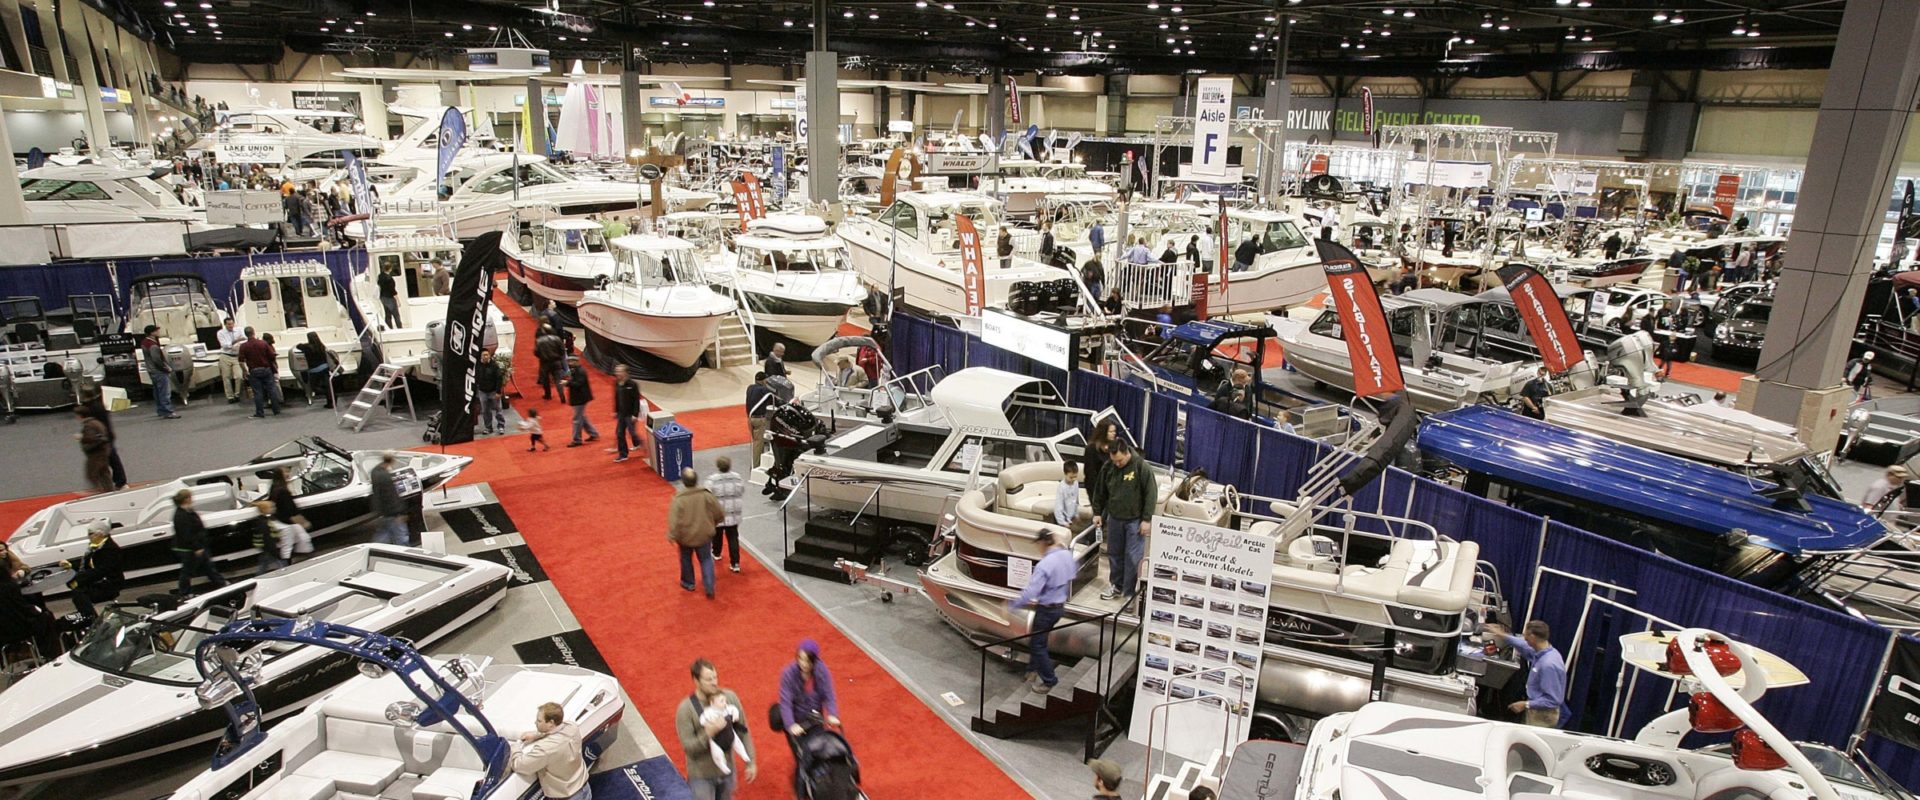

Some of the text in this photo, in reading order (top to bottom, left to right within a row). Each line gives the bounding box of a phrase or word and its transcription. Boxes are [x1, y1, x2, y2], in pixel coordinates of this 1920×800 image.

[1200, 109, 1226, 122] Aisle
[1336, 109, 1364, 131] FIEL
[1203, 133, 1218, 165] F
[985, 323, 1001, 333] BOATS
[465, 266, 490, 414] NAUTIQUE
[1159, 522, 1177, 531] Boats
[1161, 529, 1183, 538] Motors
[1243, 539, 1266, 548] Arctic
[1248, 545, 1261, 553] Cat
[1175, 545, 1238, 565] Pre-Owned &
[1160, 552, 1254, 577] Non-Current Models
[1268, 616, 1311, 632] LVAN
